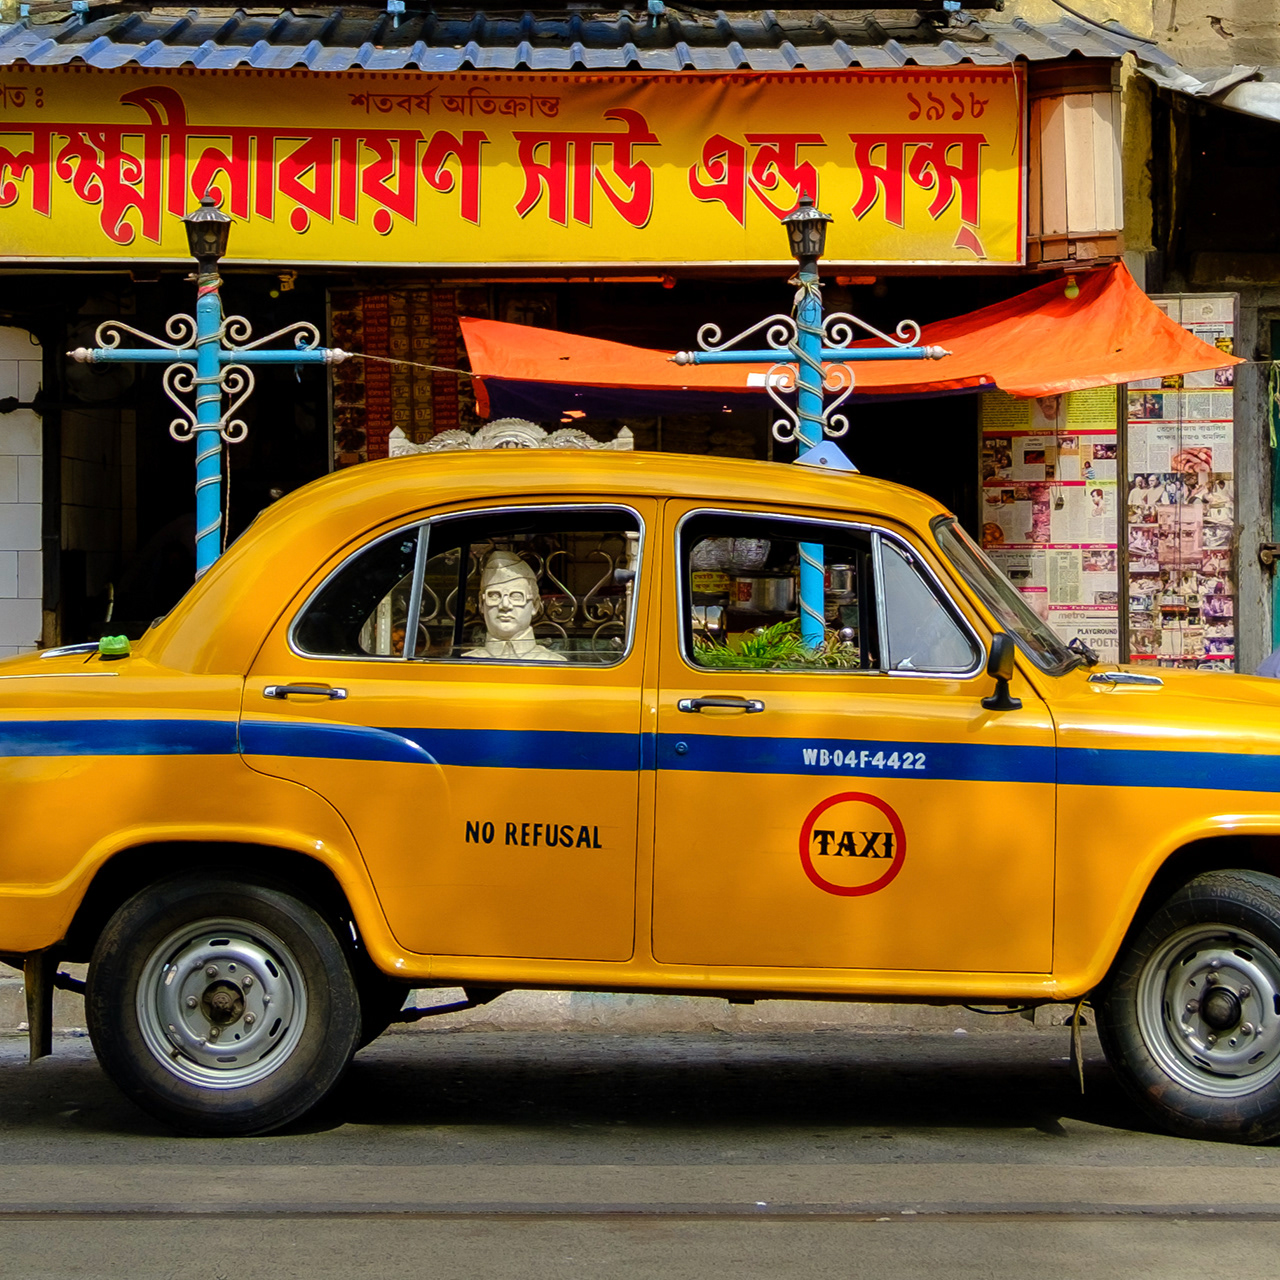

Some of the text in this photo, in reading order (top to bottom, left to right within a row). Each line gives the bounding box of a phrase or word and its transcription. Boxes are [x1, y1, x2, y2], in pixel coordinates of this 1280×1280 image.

[347, 85, 561, 119] শতবর্ষ অতিক্রান্ত
[906, 90, 990, 122] ১৯১৮
[511, 107, 662, 230] সাউ
[687, 131, 827, 228] এন্ড
[464, 821, 602, 850] NO REFUSAL
[812, 830, 895, 860] TAXI
